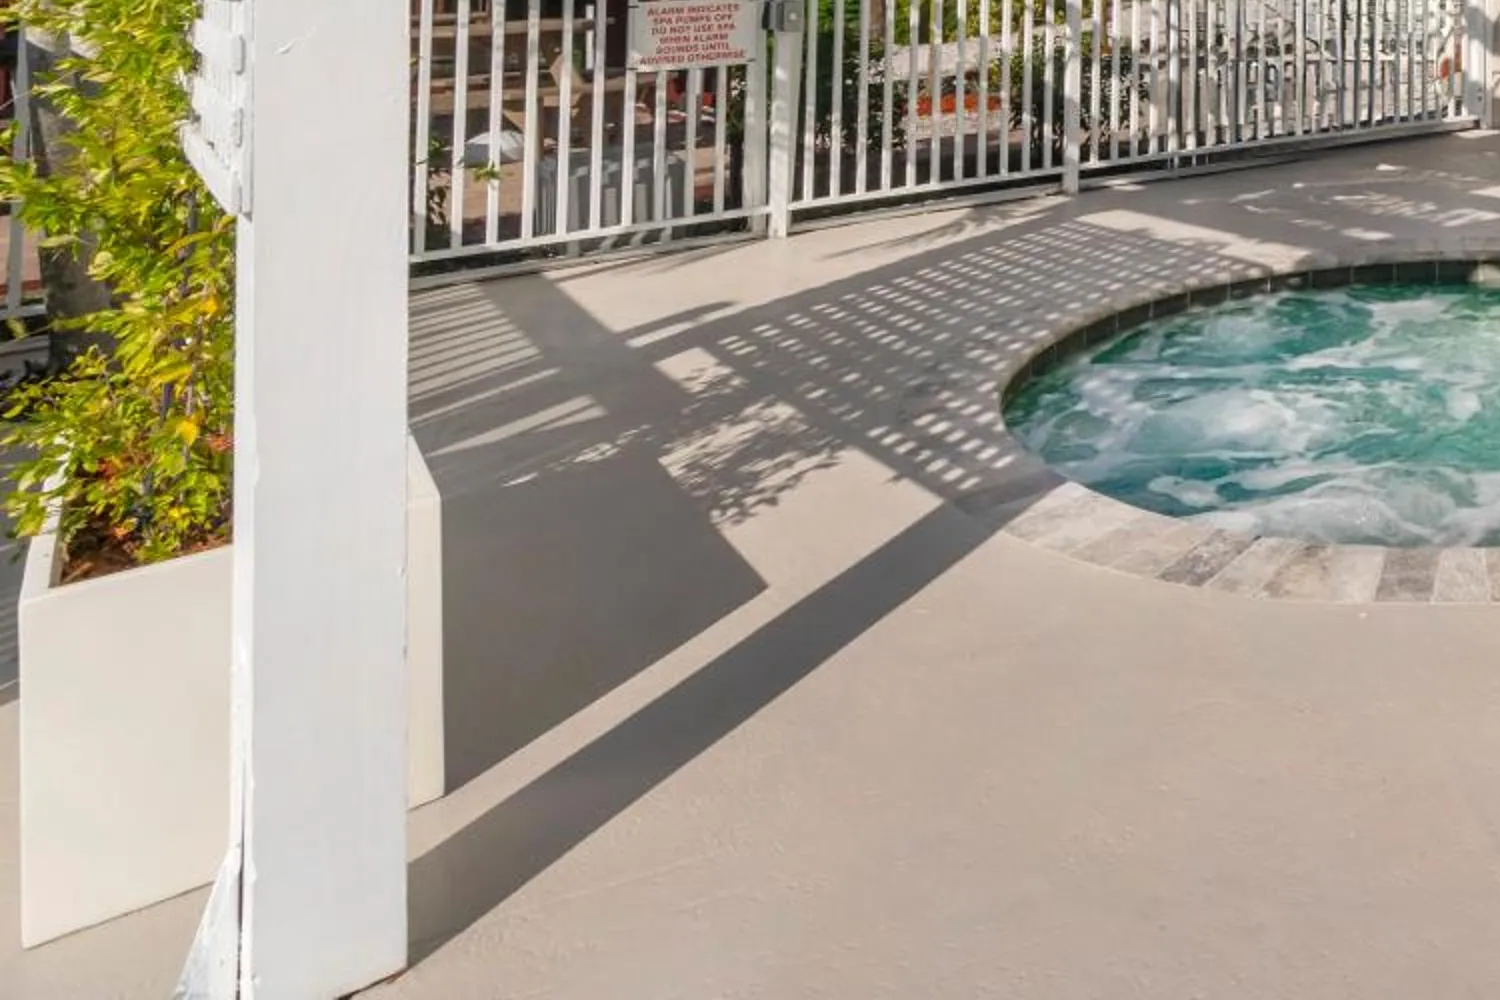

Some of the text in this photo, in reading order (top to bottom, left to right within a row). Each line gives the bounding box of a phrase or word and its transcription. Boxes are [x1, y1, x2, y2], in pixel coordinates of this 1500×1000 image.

[647, 3, 740, 16] ALARM INDICATES
[653, 13, 732, 25] SPA PUMPS OFF
[651, 22, 736, 35] DO NOT USE SPA
[659, 32, 728, 43] WHEN ALARM
[656, 42, 729, 54] SOUNDS UNTIL
[640, 50, 745, 64] ADVISED OTHERWISE
